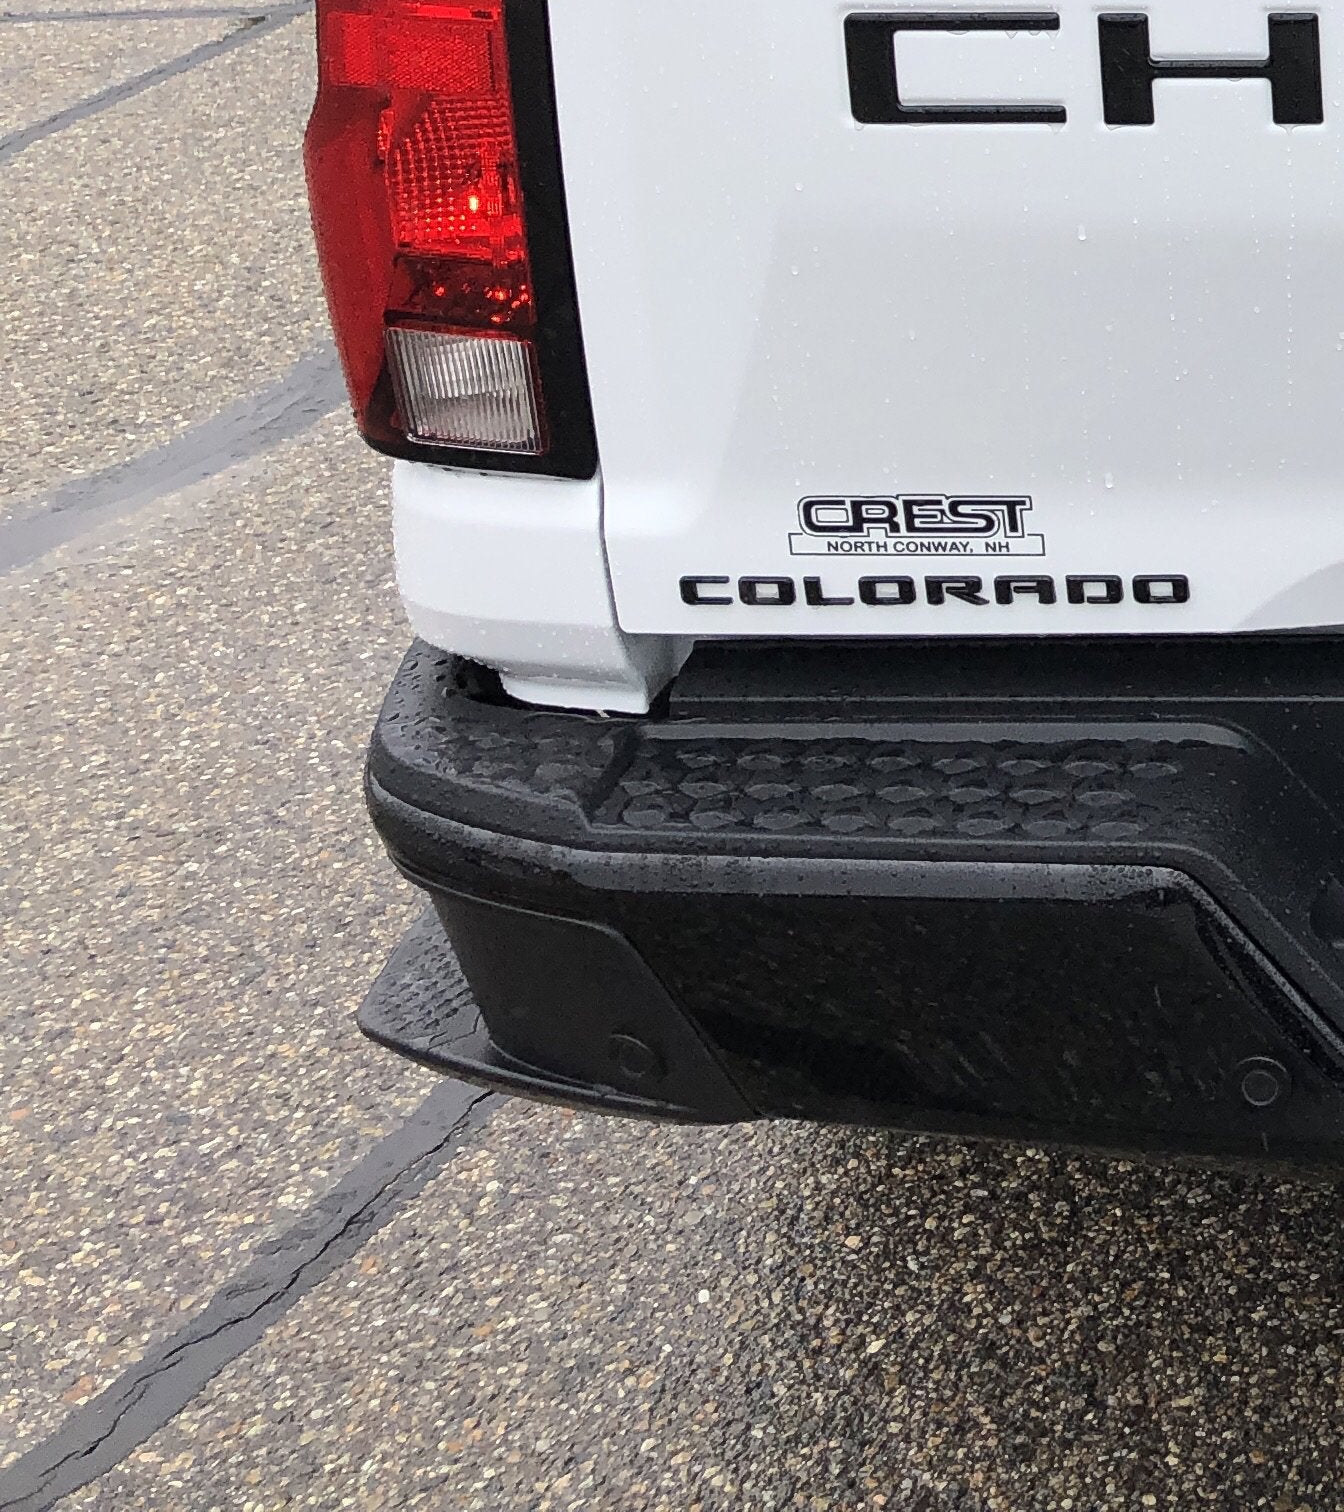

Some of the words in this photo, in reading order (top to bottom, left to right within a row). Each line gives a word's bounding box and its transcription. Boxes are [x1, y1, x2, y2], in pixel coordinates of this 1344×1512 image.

[800, 496, 1030, 536] CREST
[827, 540, 888, 553] NORTH
[893, 540, 974, 554] CONWAY,
[985, 540, 1011, 553] NH
[679, 574, 1190, 607] COLORADO
